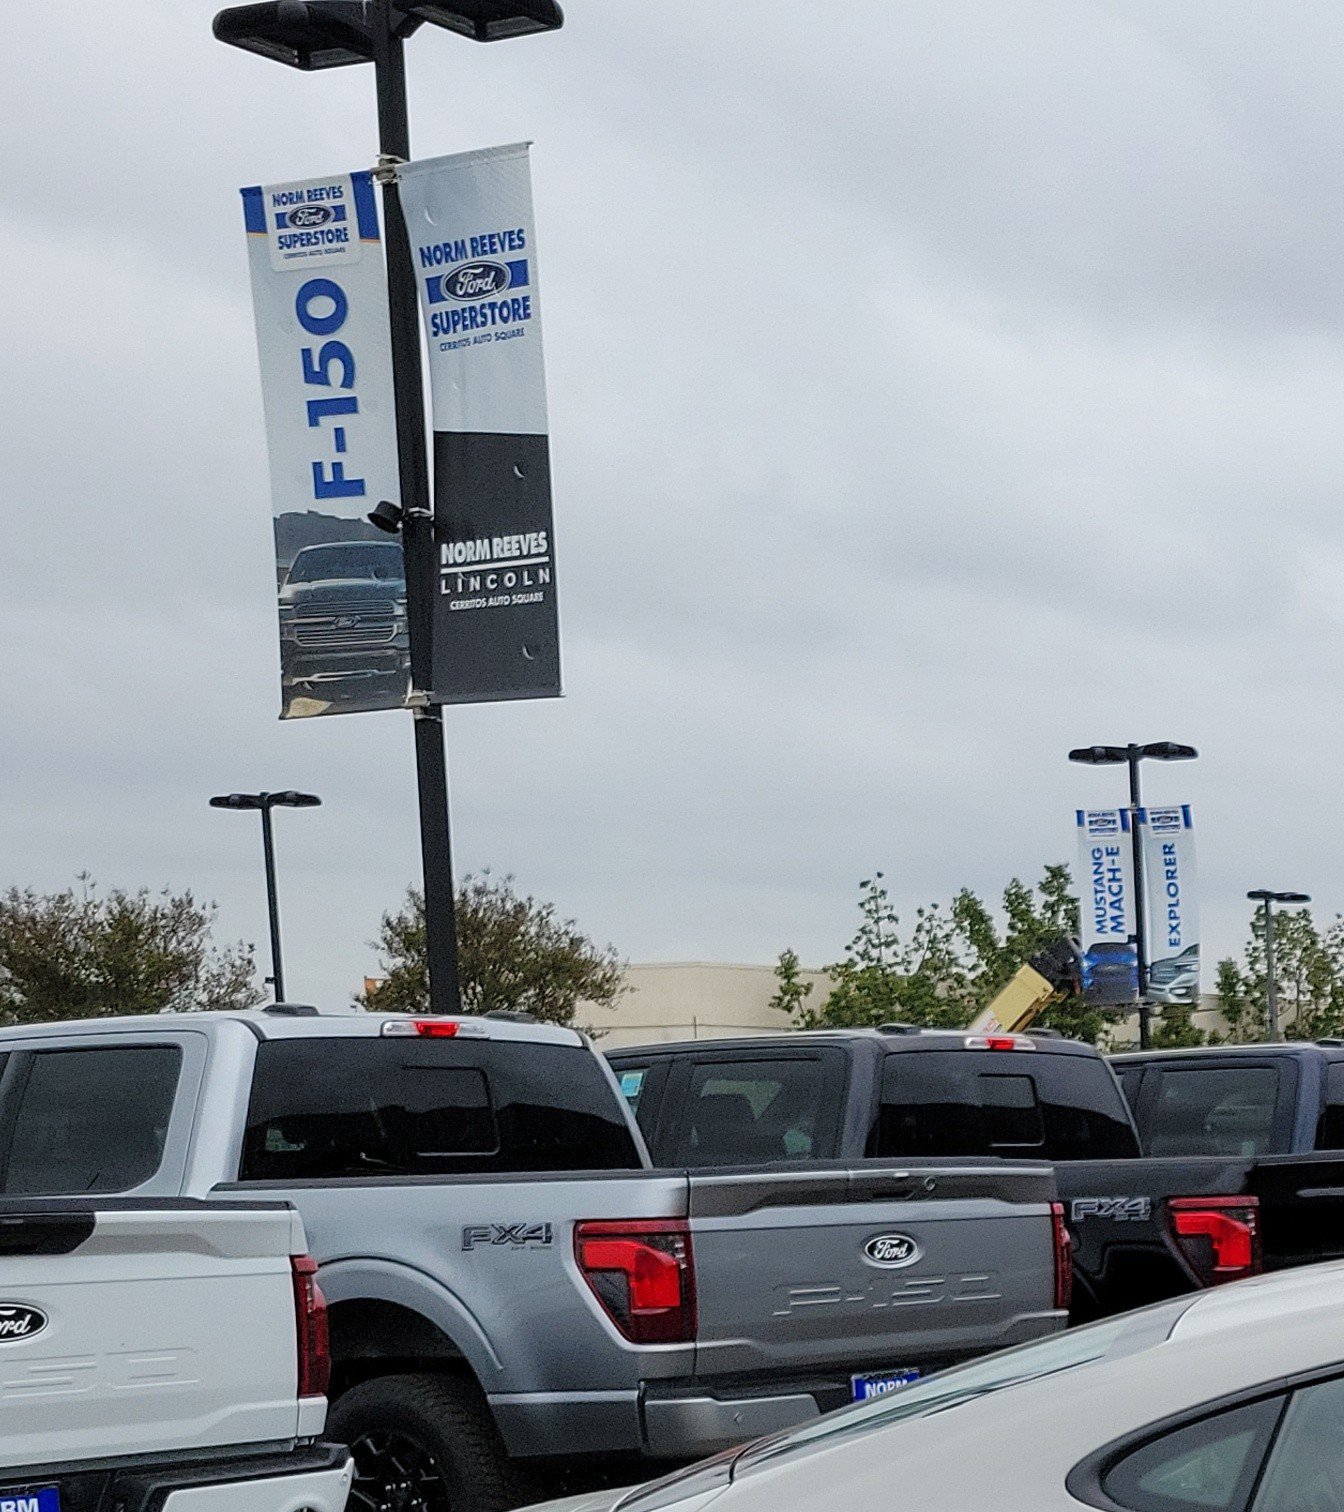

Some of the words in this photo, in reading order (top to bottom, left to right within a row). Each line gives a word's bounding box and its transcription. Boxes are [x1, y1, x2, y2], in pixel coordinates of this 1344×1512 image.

[272, 190, 305, 208] NORM
[306, 185, 344, 202] REEVES
[278, 227, 350, 250] SUPERSTORE
[419, 239, 468, 268] NORM
[470, 228, 526, 258] REEVES
[431, 296, 532, 338] SUPERSTORE
[295, 278, 366, 500] F-150
[441, 539, 491, 565] NORM
[492, 531, 548, 559] REEVES
[441, 568, 550, 595] LINCOLN
[487, 595, 511, 608] AUTO
[1091, 846, 1108, 934] MUSTANG
[1105, 846, 1125, 933] MACH-E
[1162, 842, 1181, 948] EXPLORER
[1071, 1197, 1150, 1221] FX4
[462, 1222, 553, 1251] FX4
